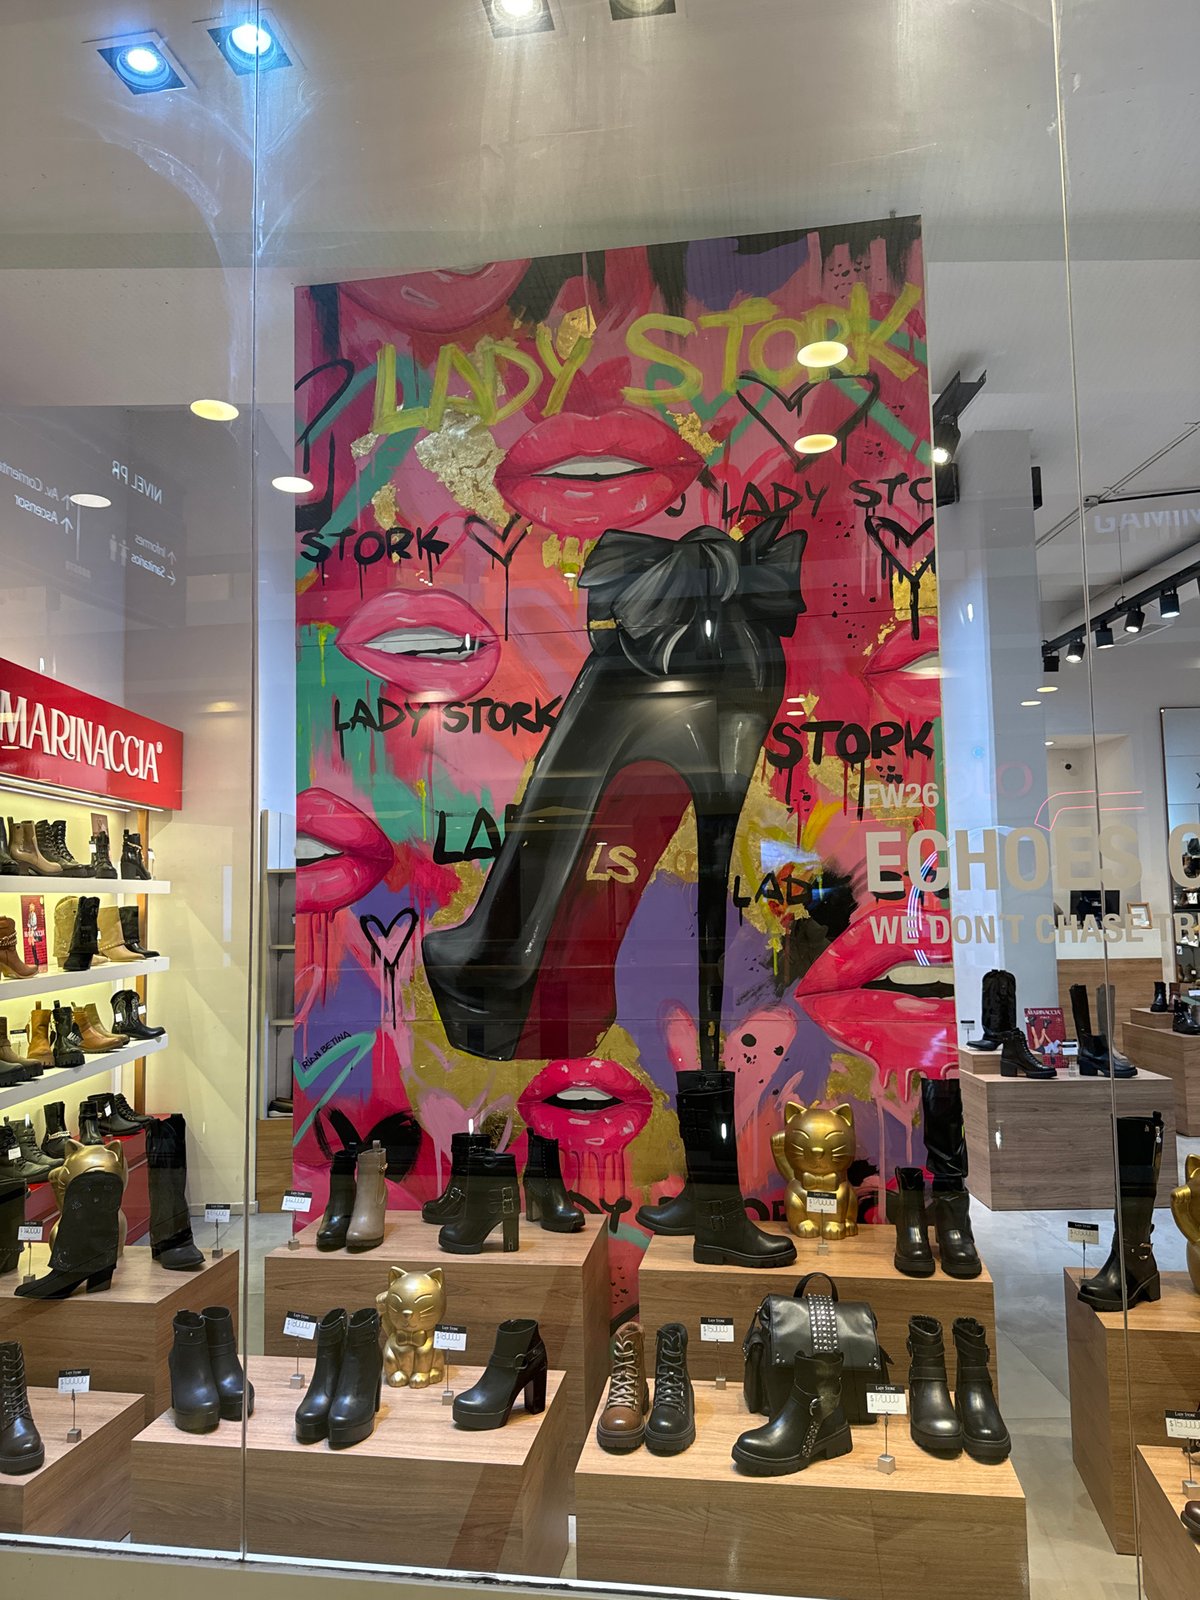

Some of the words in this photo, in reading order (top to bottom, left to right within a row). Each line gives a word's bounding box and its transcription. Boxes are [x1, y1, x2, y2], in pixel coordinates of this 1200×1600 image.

[370, 320, 594, 433] LADY
[620, 281, 923, 406] STORK
[722, 480, 827, 521] LADY
[300, 526, 449, 566] STORK
[335, 697, 430, 738] LADY
[441, 695, 563, 736] STORK
[766, 720, 935, 769] STORK
[862, 782, 940, 809] FW26
[586, 843, 640, 884] LS
[864, 825, 1142, 893] ECHOES
[869, 915, 920, 945] WE
[1035, 912, 1143, 944] CHASE
